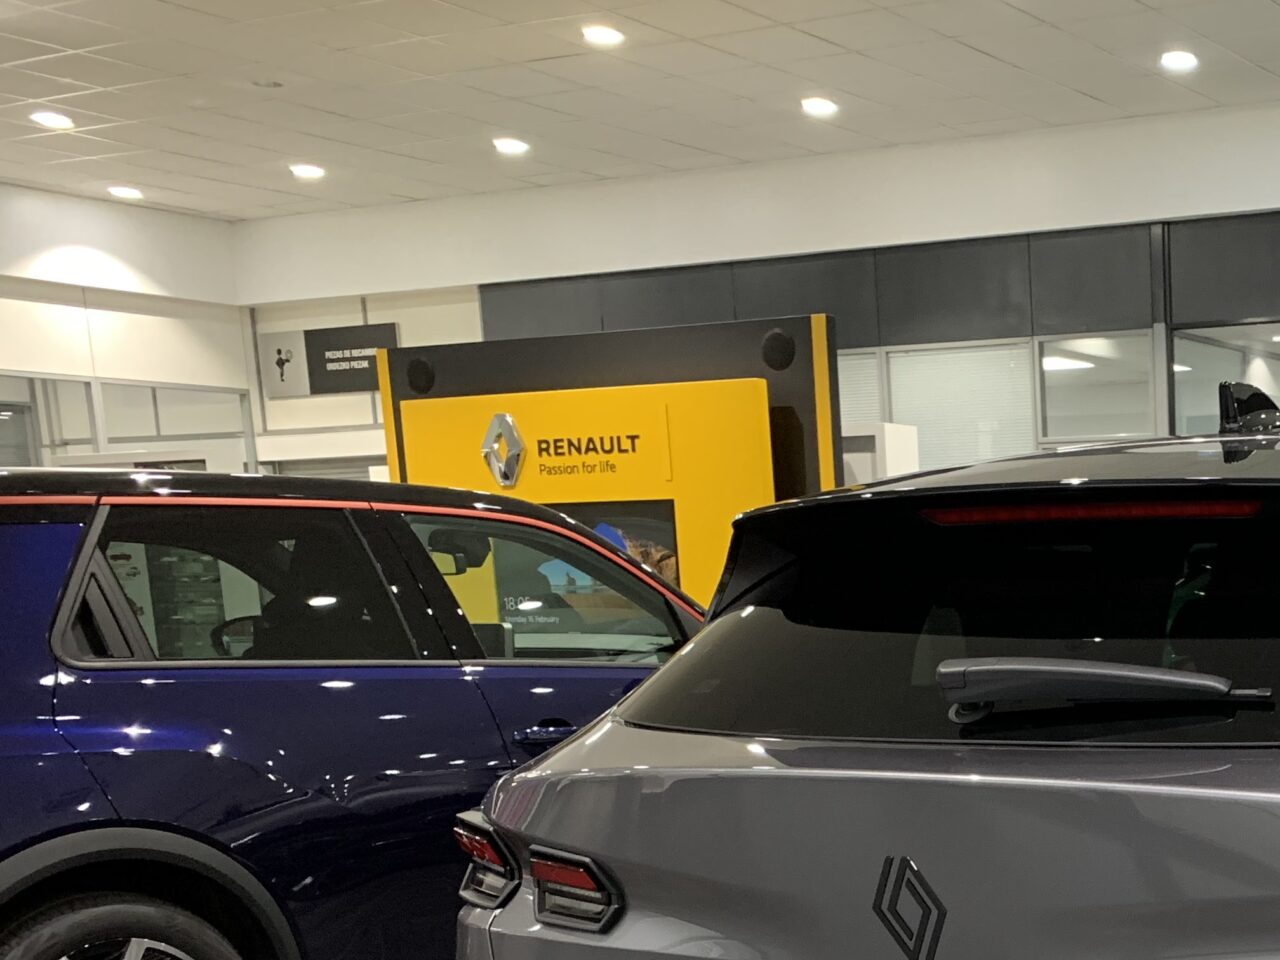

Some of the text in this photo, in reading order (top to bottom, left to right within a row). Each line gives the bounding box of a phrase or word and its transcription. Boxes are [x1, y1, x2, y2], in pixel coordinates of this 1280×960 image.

[537, 434, 640, 458] RENAULT
[539, 460, 617, 476] Passion for life
